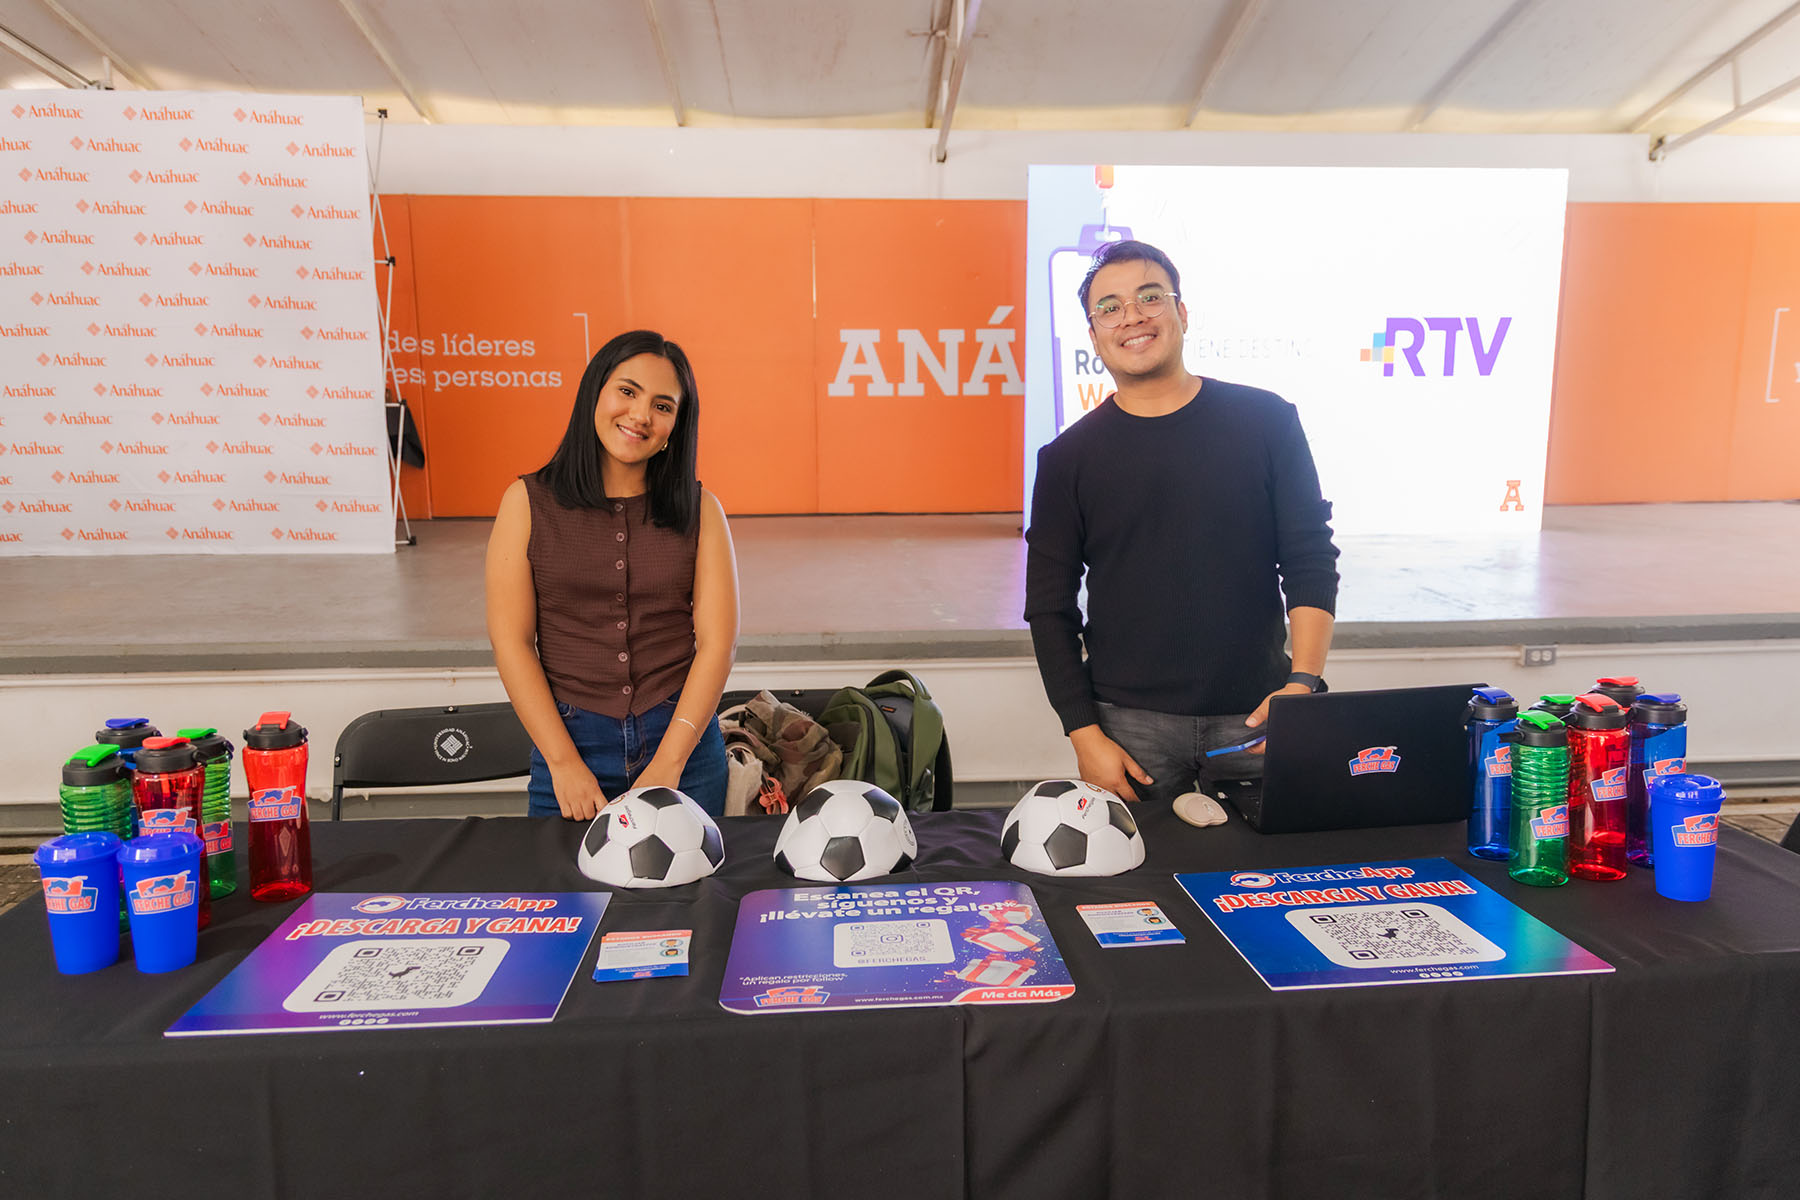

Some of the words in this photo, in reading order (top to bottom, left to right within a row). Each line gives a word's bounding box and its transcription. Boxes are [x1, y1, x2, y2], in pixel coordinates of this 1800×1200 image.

[29, 104, 83, 120] Anáhuac
[140, 106, 193, 120] Anáhuac
[249, 109, 304, 125] Anáhuac
[86, 136, 142, 152] Anáhuac
[196, 137, 248, 153] Anáhuac
[302, 143, 355, 159] Anáhuac
[35, 166, 89, 182] Anáhuac
[145, 168, 200, 184] Anáhuac
[254, 174, 308, 189] Anáhuac
[92, 200, 146, 216] Anáhuac
[201, 200, 254, 216] Anáhuac
[307, 204, 360, 220] Anáhuac
[40, 230, 94, 246] Anáhuac
[150, 232, 204, 248] Anáhuac
[260, 234, 312, 250] Anáhuac
[96, 262, 151, 278] Anáhuac
[205, 262, 258, 278] Anáhuac
[312, 266, 366, 280] Anáhuac
[46, 290, 101, 306] Anáhuac
[155, 292, 208, 307] Anáhuac
[264, 296, 317, 312] Anáhuac
[104, 323, 158, 336] Anáhuac
[210, 322, 264, 338] Anáhuac
[317, 328, 368, 344] Anáhuac
[441, 333, 536, 356] líderes
[828, 305, 1025, 396] ANÁ
[1383, 317, 1512, 376] RTV
[53, 352, 106, 368] Anáhuac
[161, 352, 215, 368] Anáhuac
[269, 355, 322, 370] Anáhuac
[434, 369, 563, 391] personas
[3, 384, 56, 400] Anáhuac
[110, 384, 164, 400] Anáhuac
[216, 384, 268, 400] Anáhuac
[322, 386, 376, 400] Anáhuac
[59, 411, 112, 424] Anáhuac
[167, 410, 221, 424] Anáhuac
[274, 412, 326, 427] Anáhuac
[10, 441, 64, 456] Anáhuac
[117, 440, 168, 456] Anáhuac
[222, 440, 272, 456] Anáhuac
[325, 441, 377, 456] Anáhuac
[68, 470, 120, 484] Anáhuac
[174, 469, 226, 484] Anáhuac
[280, 472, 332, 488] Anáhuac
[18, 498, 72, 512] Anáhuac
[124, 497, 176, 512] Anáhuac
[229, 498, 280, 512] Anáhuac
[330, 498, 382, 512] Anáhuac
[77, 528, 128, 544] Anáhuac
[182, 527, 232, 540] Anáhuac
[286, 528, 336, 544] Anáhuac
[1353, 762, 1380, 773] FERCHE
[1381, 760, 1396, 770] GAS
[281, 804, 298, 816] GAS
[1677, 832, 1711, 844] FERCHE
[1276, 866, 1415, 884] FercheApp
[134, 896, 171, 911] FERCHE
[173, 891, 192, 906] GAS
[793, 891, 899, 902] Escanea
[905, 887, 928, 897] el
[933, 886, 980, 897] QR,
[1213, 886, 1363, 913] ¡DESCARGA
[1357, 884, 1387, 901] Y
[1384, 880, 1478, 899] GANA!
[68, 896, 92, 910] GAS
[405, 896, 558, 912] FercheApp
[816, 897, 938, 911] síguenos
[942, 896, 959, 906] y
[759, 908, 861, 923] ¡llévate
[867, 907, 902, 915] un
[284, 917, 460, 940] ¡DESCARGA
[464, 916, 485, 934] Y
[487, 915, 583, 934] GANA!
[1389, 964, 1480, 974] www.ferchegas.com
[981, 991, 1005, 999] Me
[1007, 990, 1027, 998] da
[1030, 989, 1061, 998] Más
